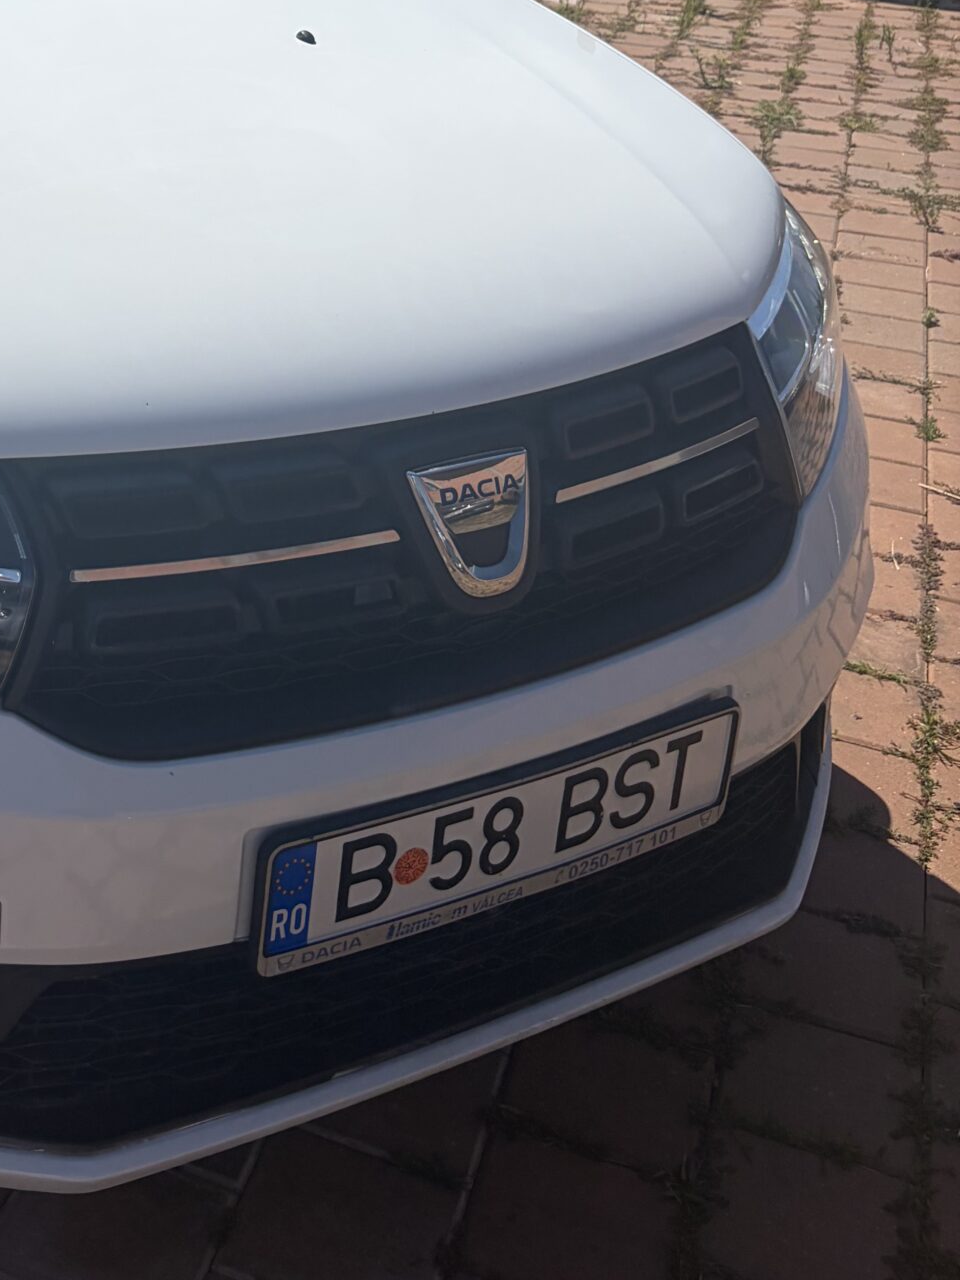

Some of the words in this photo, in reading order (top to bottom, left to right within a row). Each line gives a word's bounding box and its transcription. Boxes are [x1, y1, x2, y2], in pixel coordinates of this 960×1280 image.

[440, 474, 520, 506] DACIA
[334, 832, 397, 923] B
[429, 796, 525, 891] 58
[554, 730, 704, 855] BST
[270, 903, 308, 942] RO
[302, 937, 362, 963] DACIA
